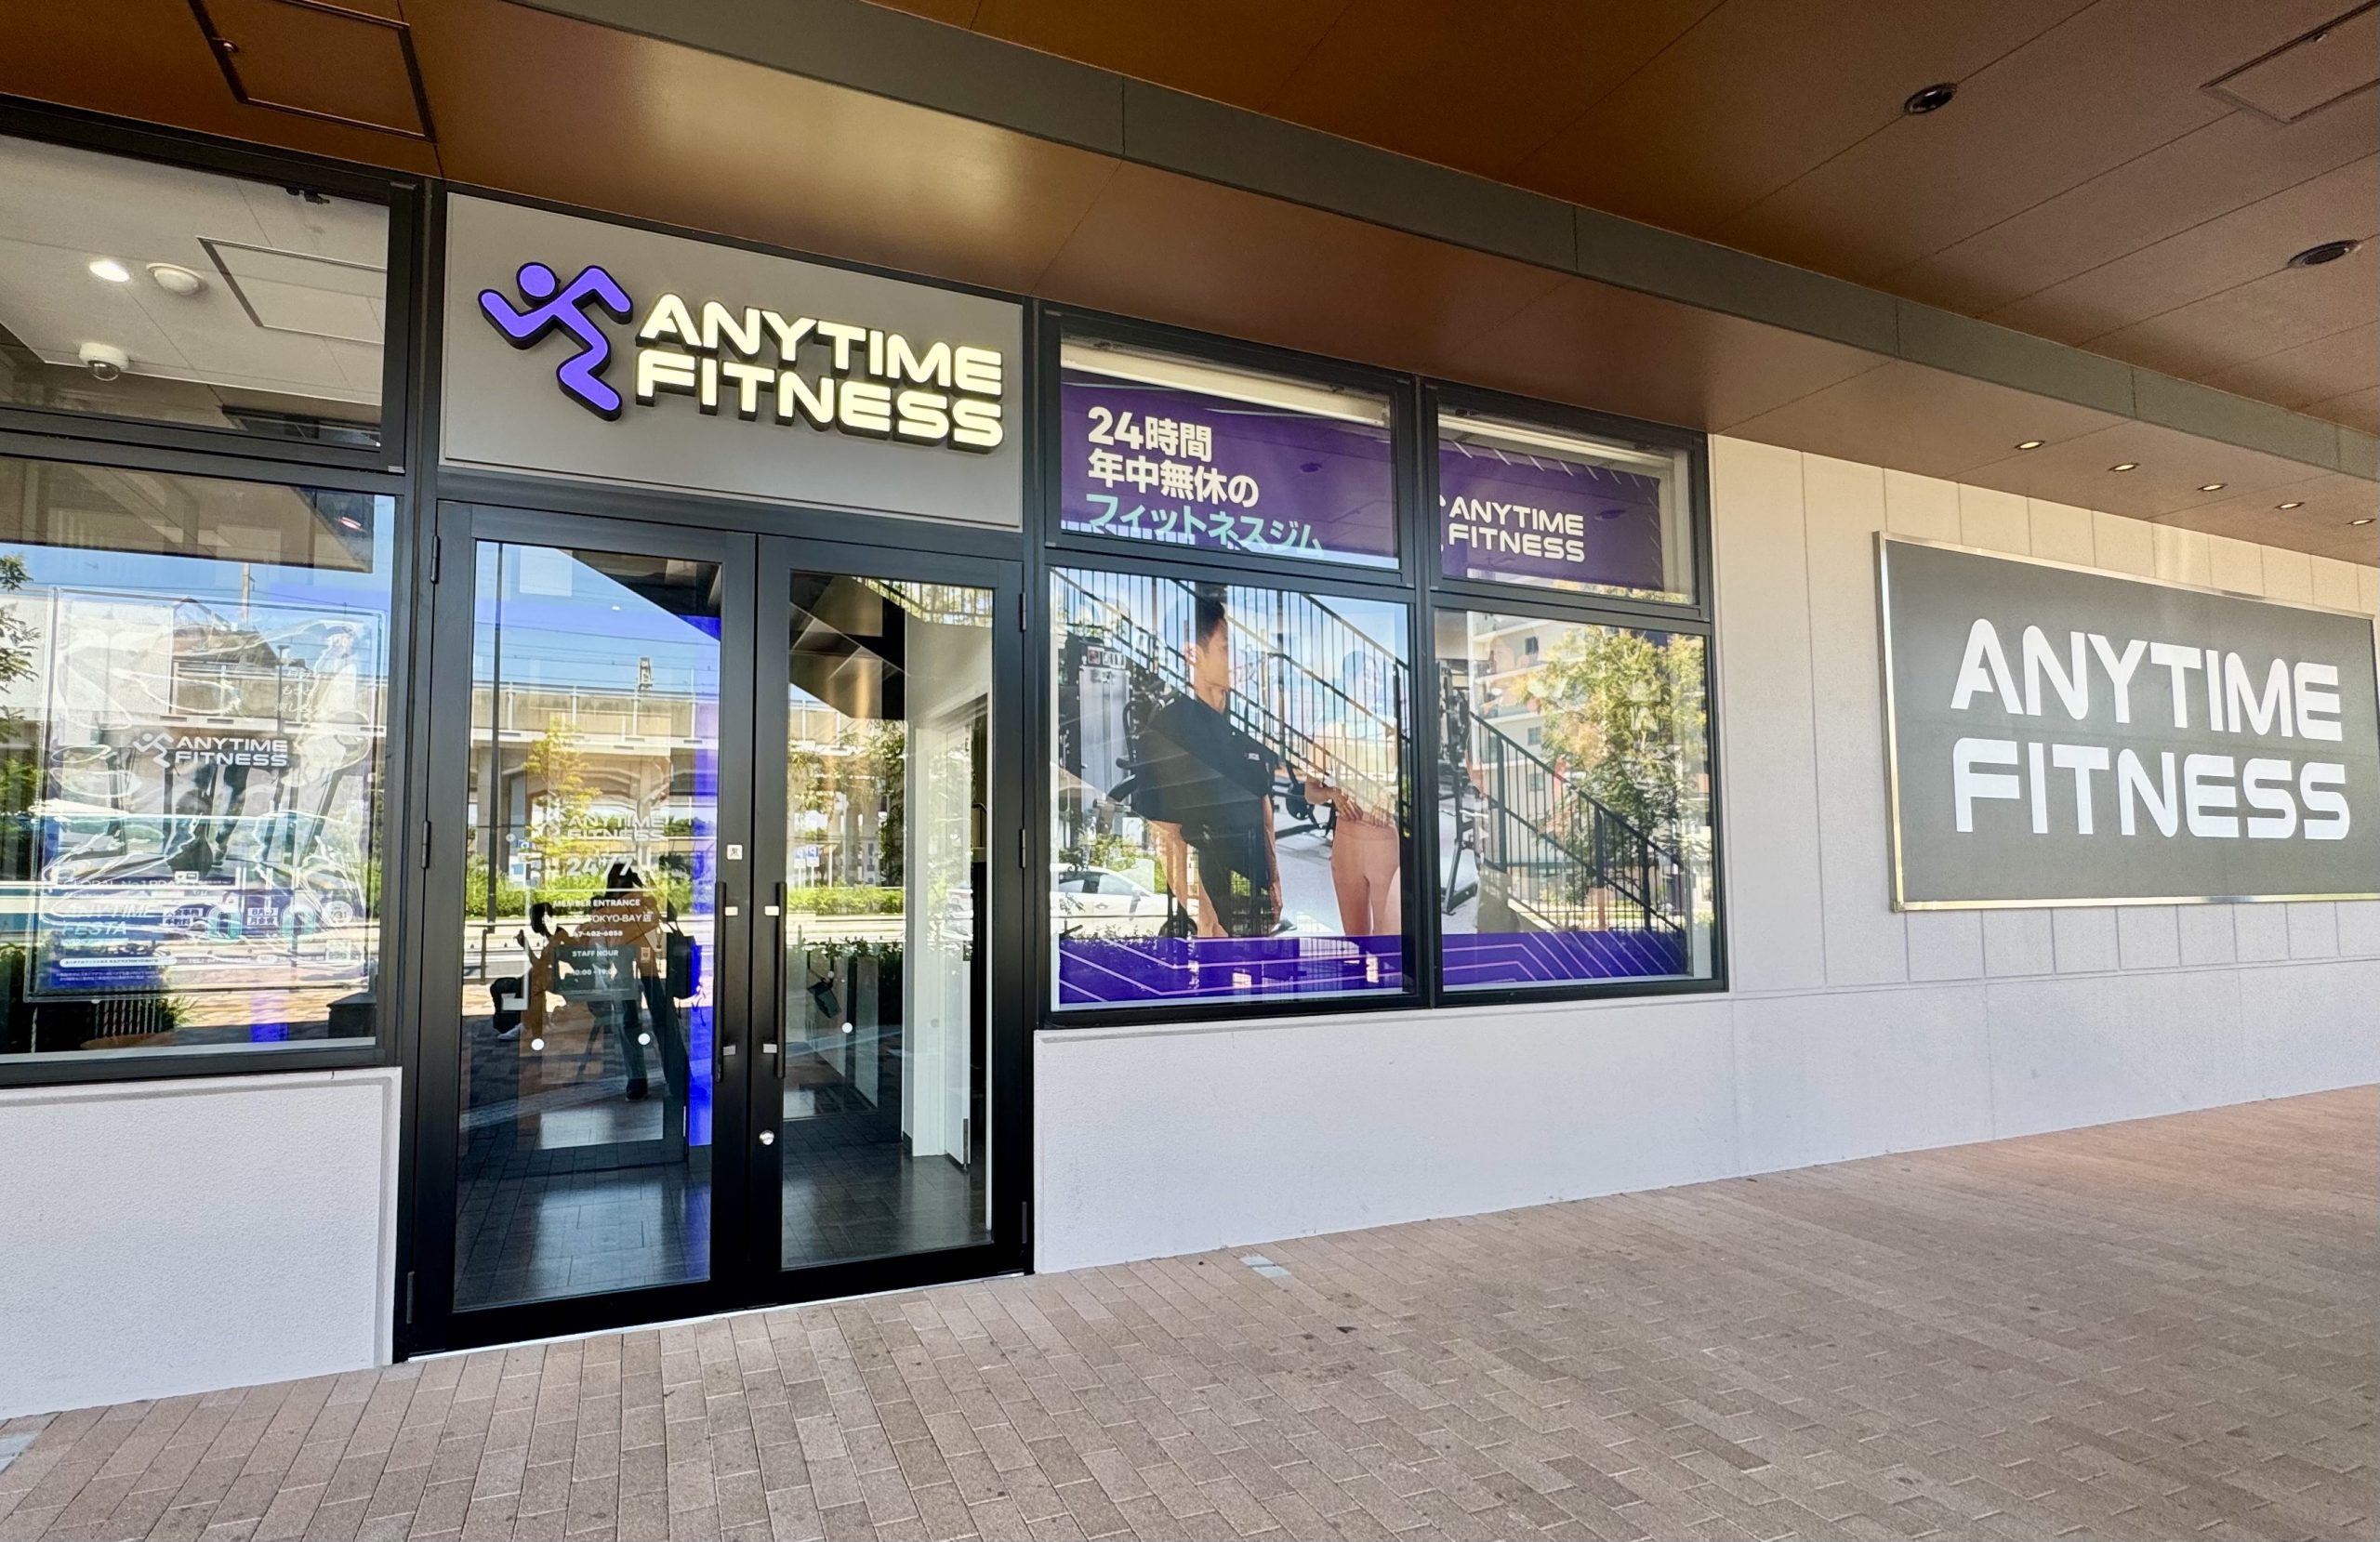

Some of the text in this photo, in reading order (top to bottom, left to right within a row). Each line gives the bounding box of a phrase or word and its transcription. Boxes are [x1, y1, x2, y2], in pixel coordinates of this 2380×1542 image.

[637, 293, 1003, 398] ANYTIME
[637, 349, 1005, 449] FITNESS
[1088, 406, 1212, 462] 24時間
[1088, 448, 1260, 507] 年中無休の
[1086, 494, 1324, 557] フィットネスジム
[1448, 495, 1584, 536] ANYTIME
[1448, 522, 1585, 562] FITNESS
[1950, 618, 2343, 742] ANYTIME
[175, 736, 288, 753] ANYTIME
[175, 751, 288, 767] FITNESS
[1953, 737, 2350, 840] FITNESS
[567, 814, 666, 828] ANYTIME
[567, 828, 666, 842] FITNESS
[552, 899, 641, 908] MEMBER ENTRANCE
